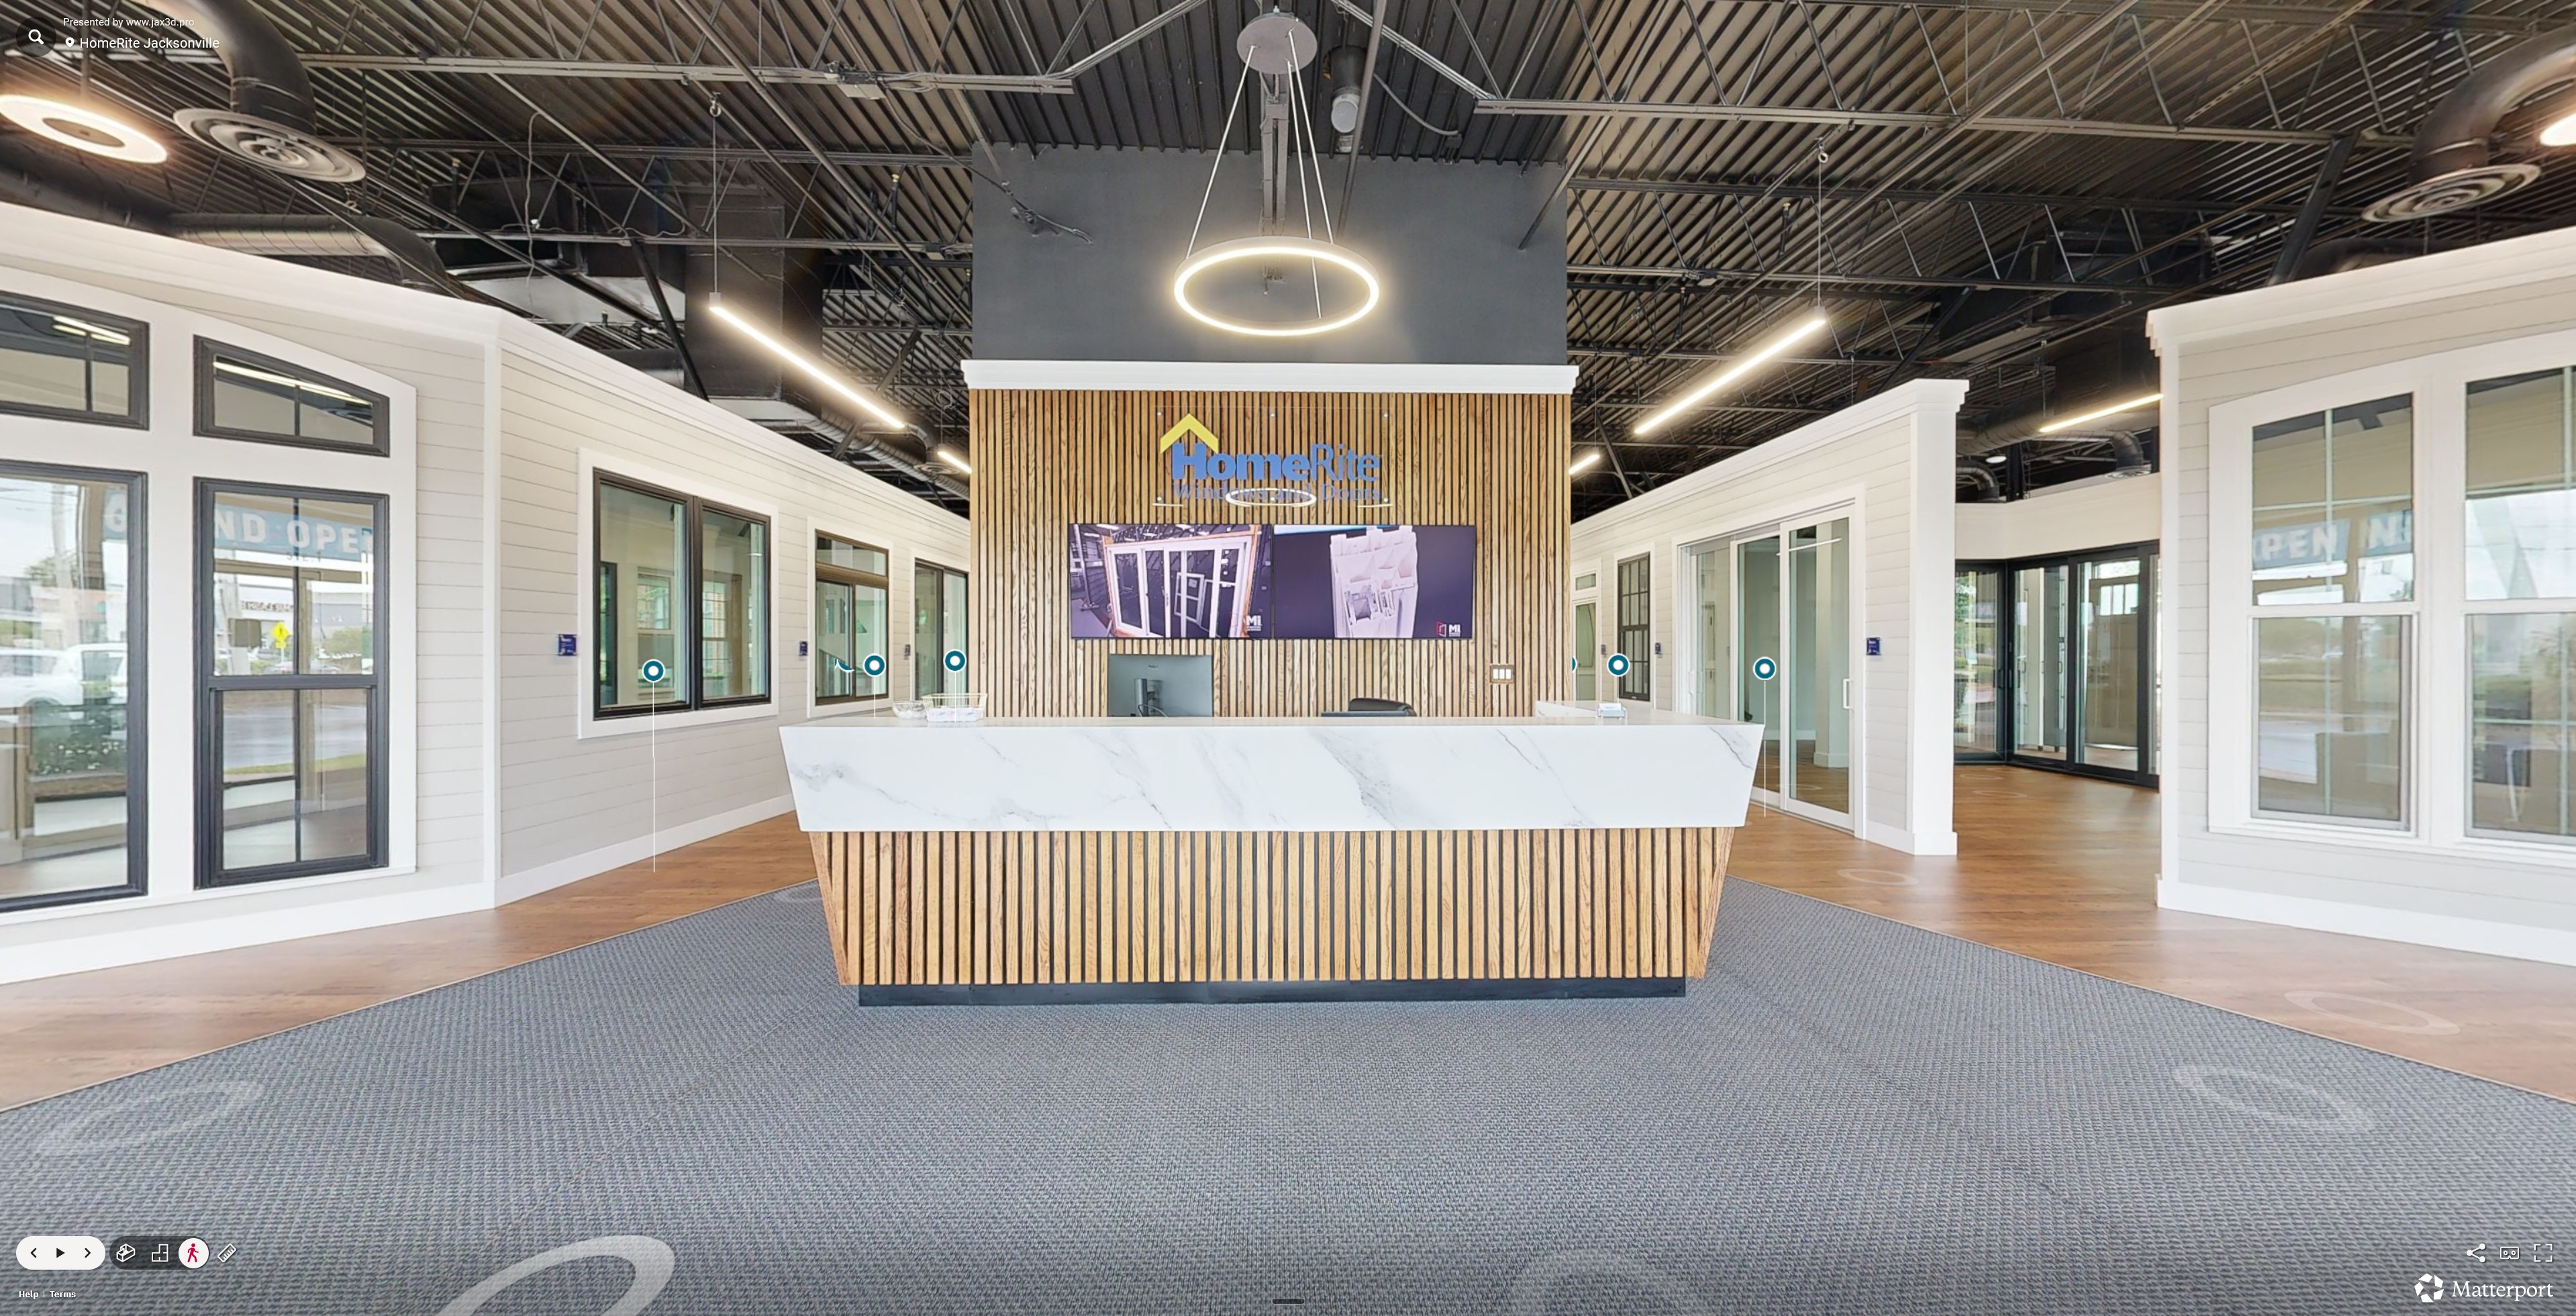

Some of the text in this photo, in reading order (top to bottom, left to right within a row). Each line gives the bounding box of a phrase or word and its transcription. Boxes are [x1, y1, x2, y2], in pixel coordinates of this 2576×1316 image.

[1172, 442, 1379, 481] HomeRite
[1173, 483, 1380, 500] Windows and Doors
